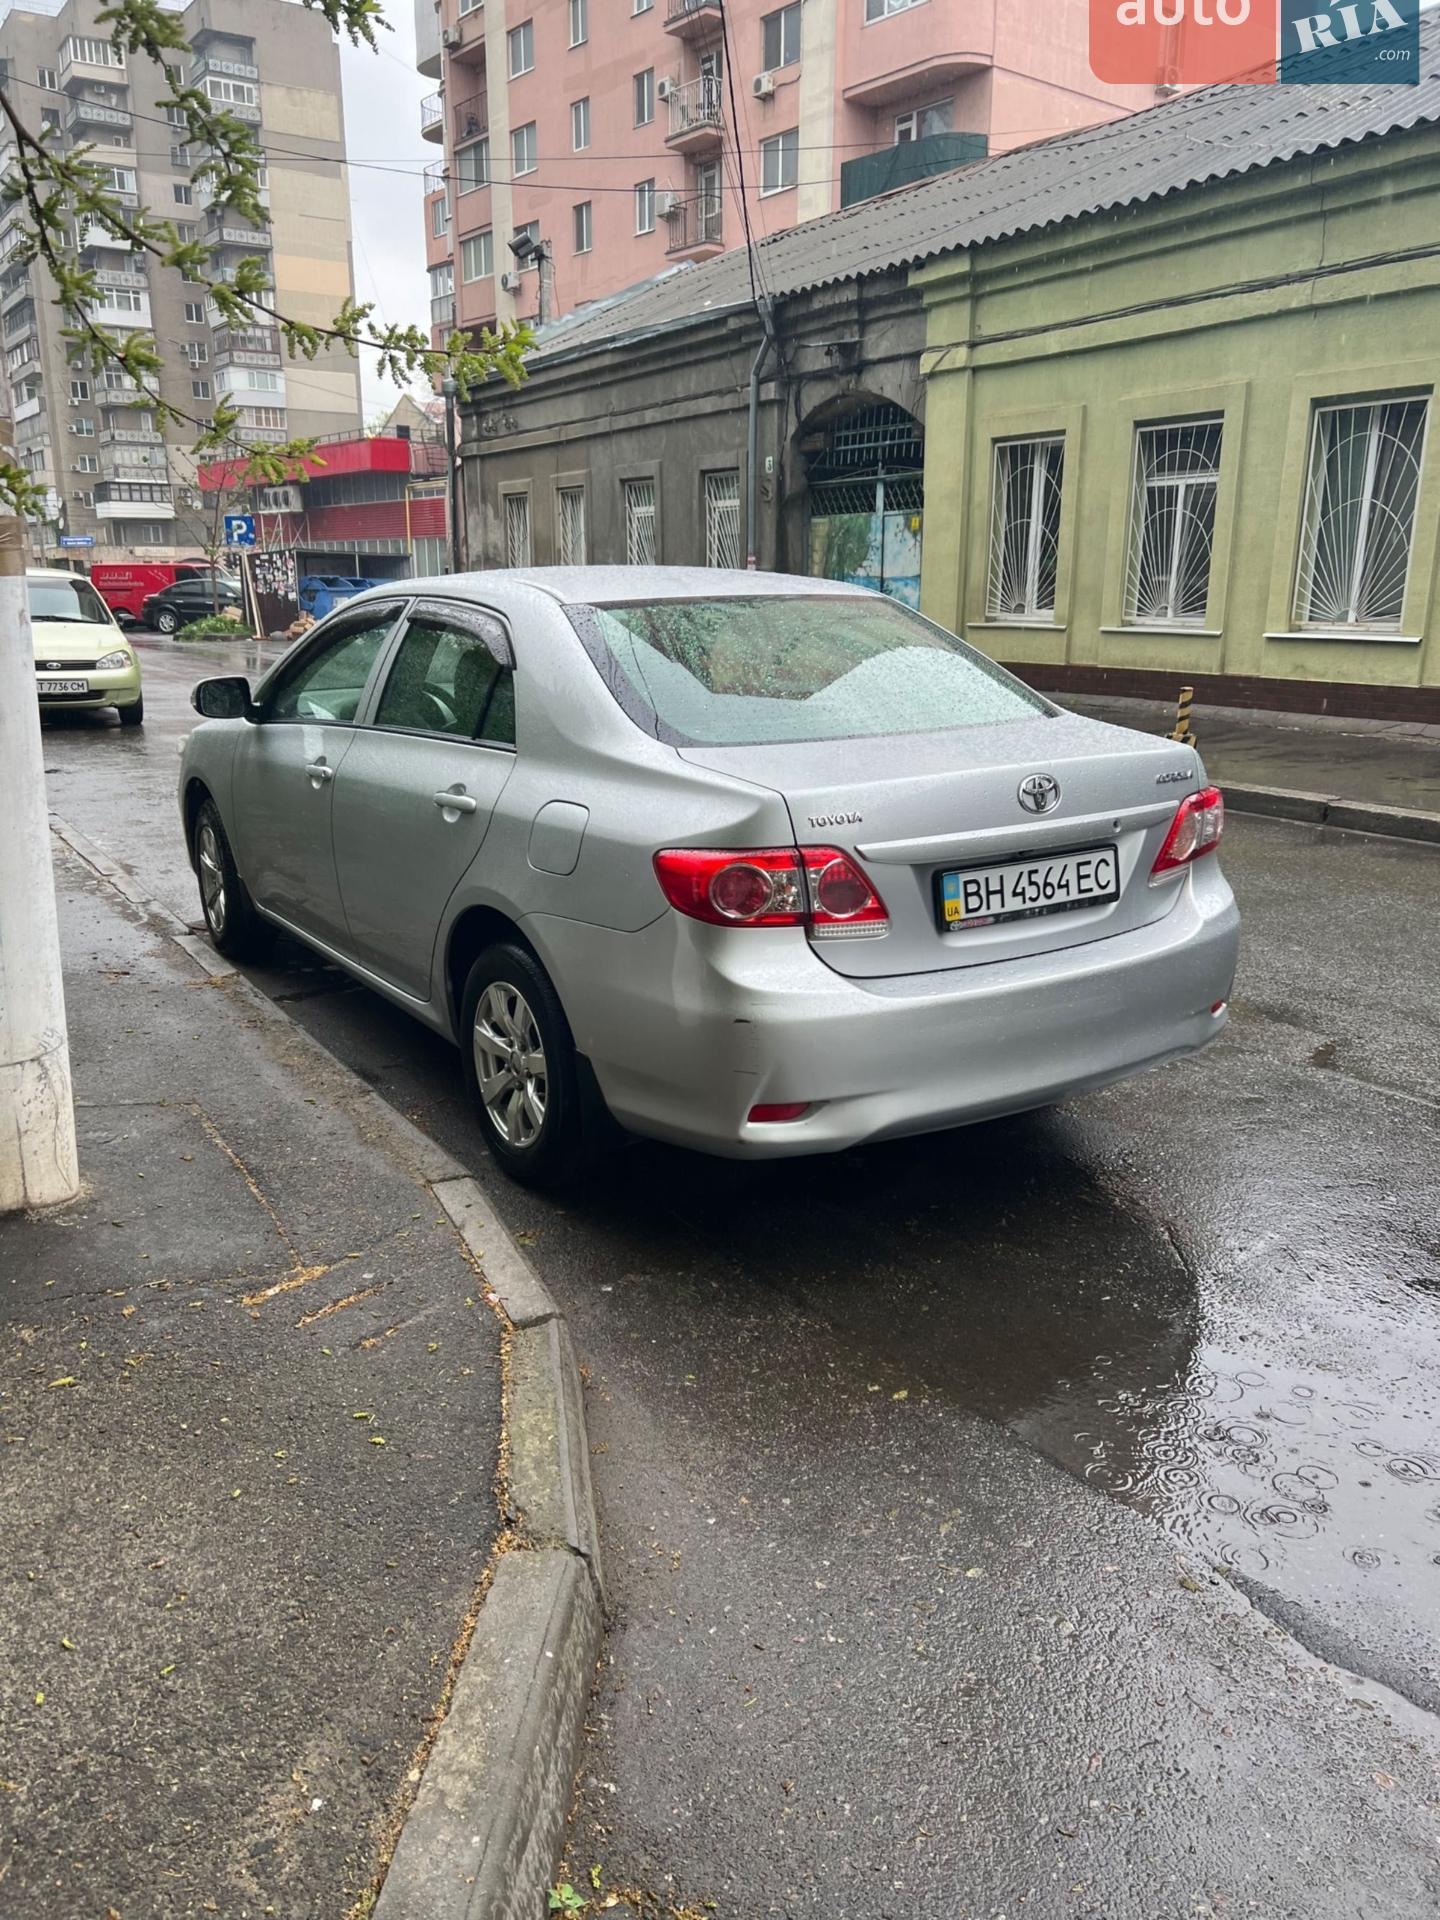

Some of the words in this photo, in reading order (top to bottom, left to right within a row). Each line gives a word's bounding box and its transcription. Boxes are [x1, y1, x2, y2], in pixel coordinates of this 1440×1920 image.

[231, 520, 247, 541] P
[47, 682, 69, 691] 7736
[70, 682, 85, 691] CM
[808, 812, 863, 828] TOYOTA
[963, 874, 1005, 914] BH
[1012, 864, 1070, 904] 4564
[1076, 858, 1111, 894] EC
[947, 906, 960, 917] UA
